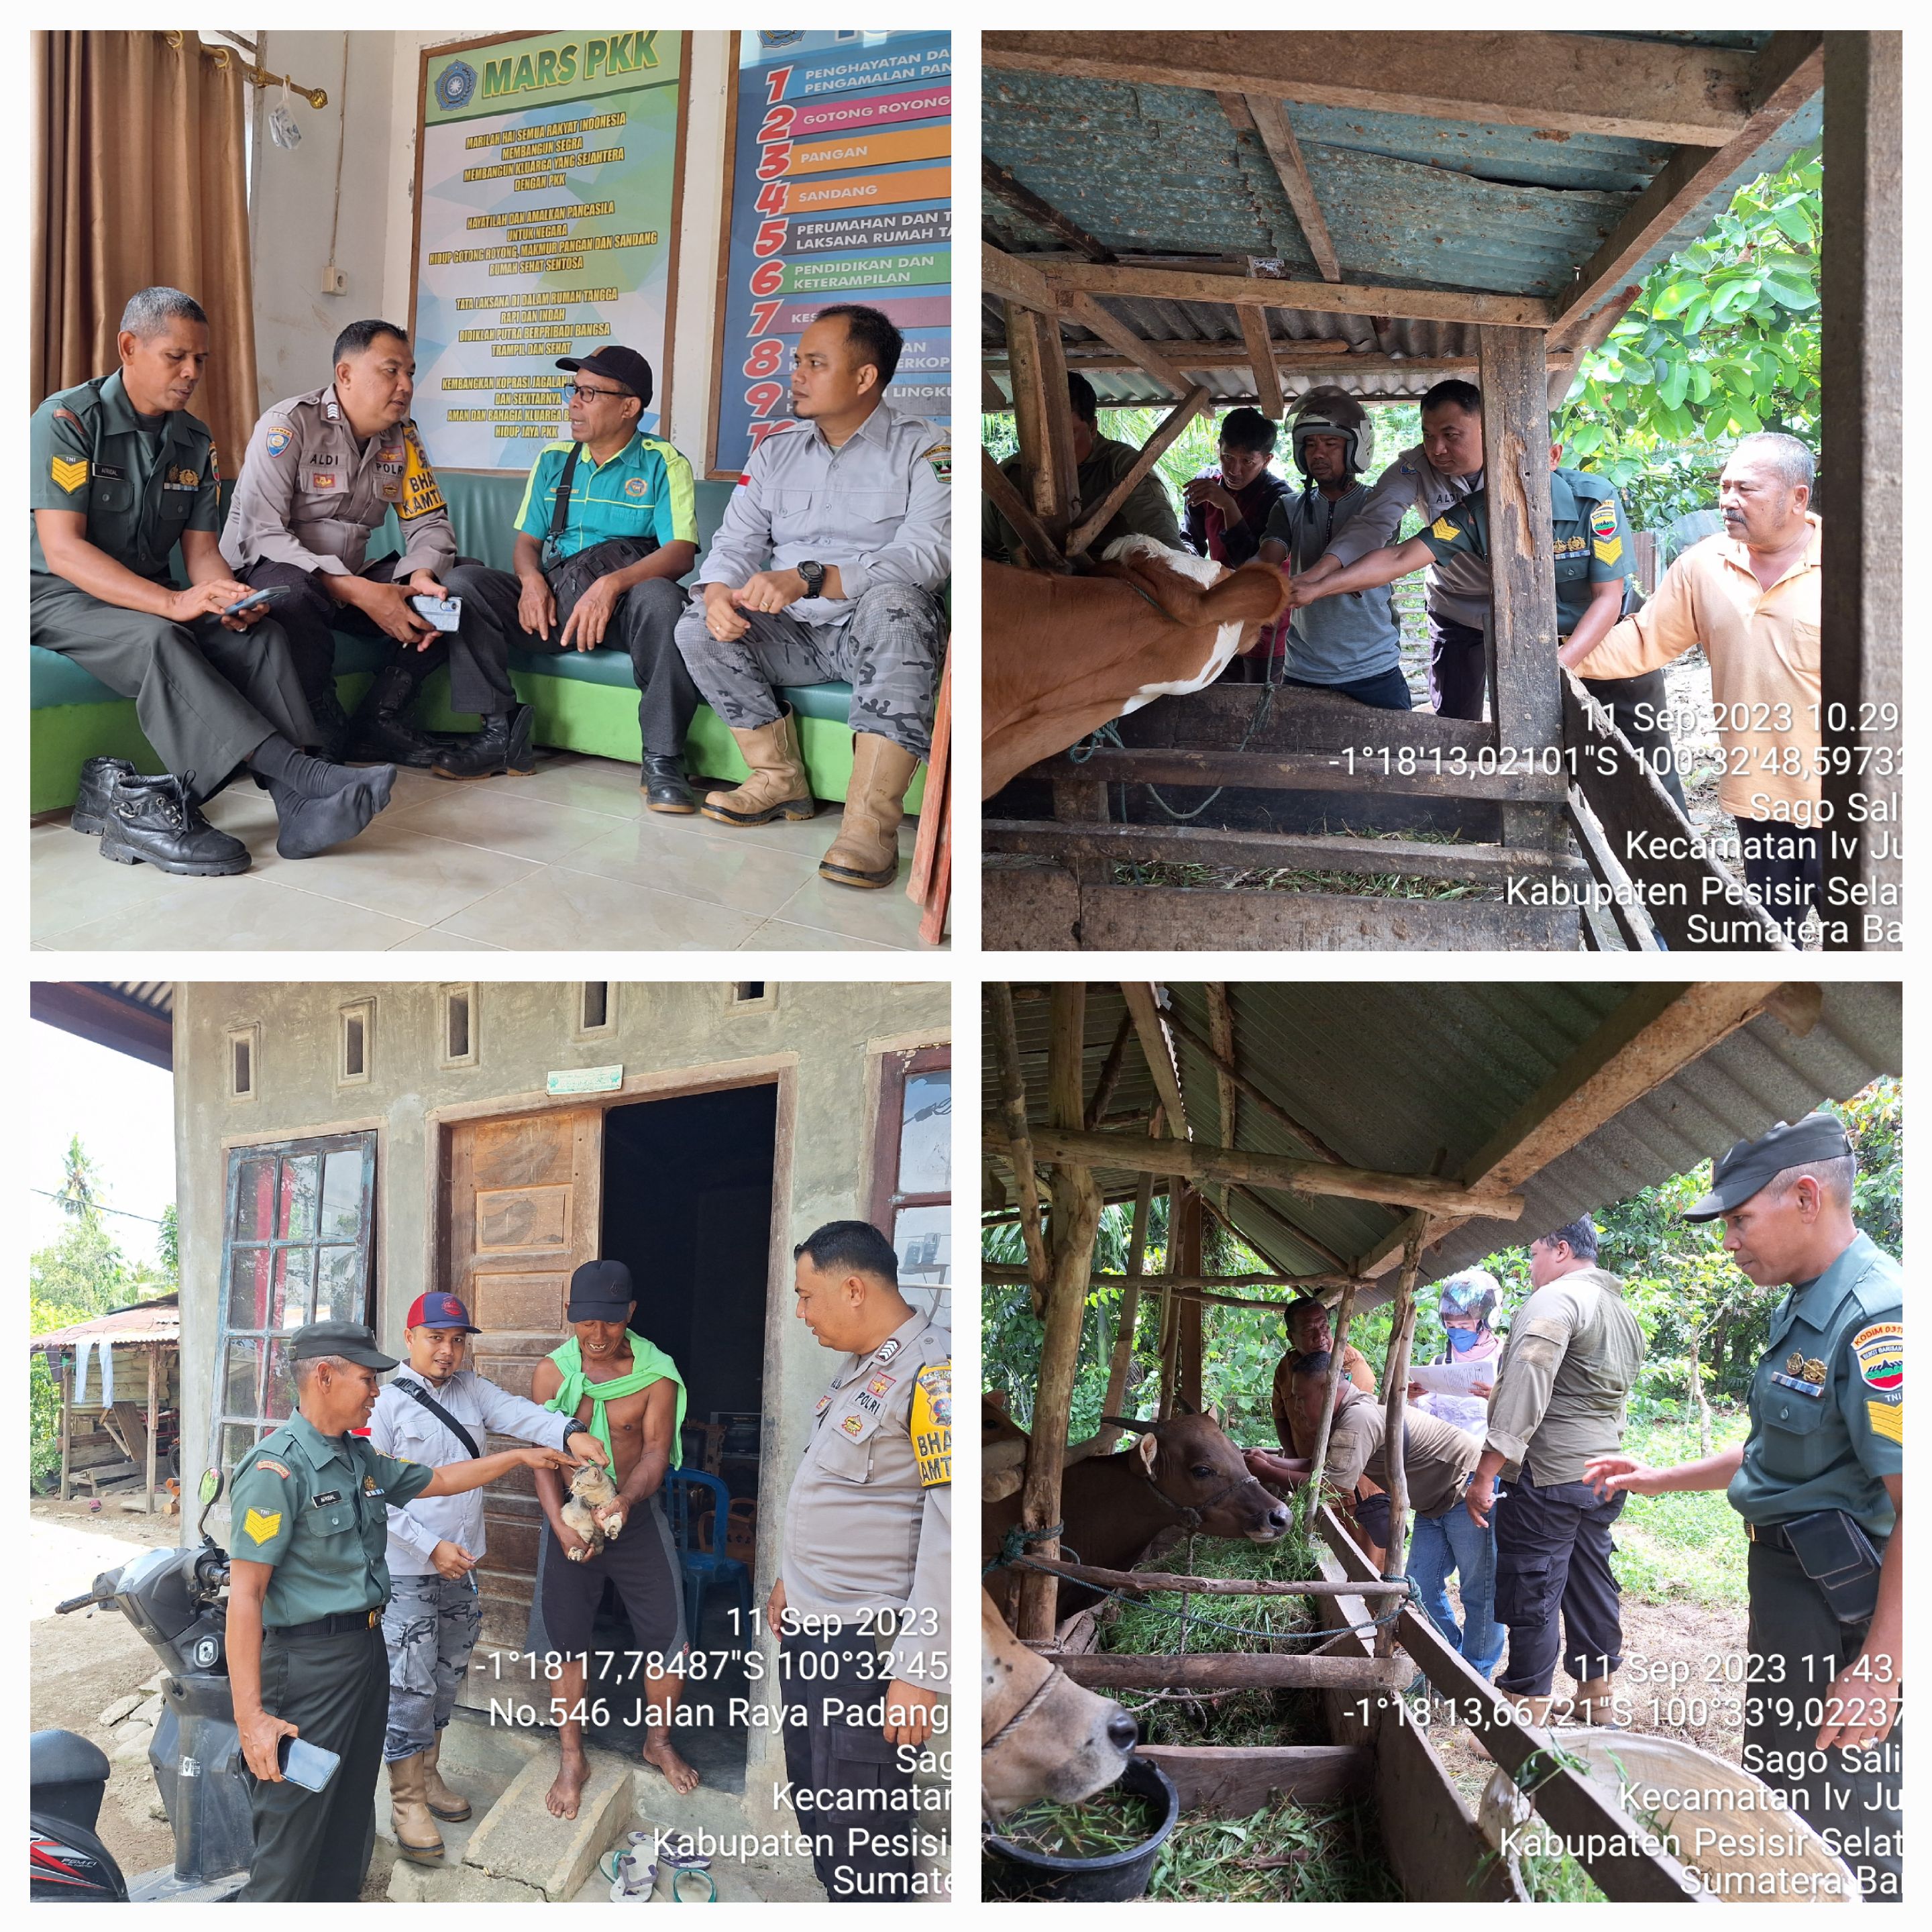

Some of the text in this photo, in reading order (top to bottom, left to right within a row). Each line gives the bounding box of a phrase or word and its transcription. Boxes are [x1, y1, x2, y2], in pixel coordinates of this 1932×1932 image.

[482, 30, 661, 99] MARS PKK
[805, 53, 921, 80] PENGHAYATAN
[765, 65, 794, 105] 1
[805, 68, 915, 93] PENGAMALAN
[803, 96, 951, 125] GOTONG ROYONG
[466, 111, 627, 150] MARILAH HAI SEMUA RAKYAT INDONESIA
[756, 104, 797, 144] 2
[502, 136, 583, 161] MEMBANGUN SEGRA
[800, 146, 867, 164] PANGAN
[464, 147, 625, 182] MEMBANGUN KLUARGA YANG SEJAHTERA
[756, 139, 794, 181] 3
[515, 172, 566, 192] DENGAN PKK
[753, 180, 791, 218] 4
[798, 184, 877, 203] SANDANG
[466, 201, 615, 230] HAYATILAH DAN AMALKAN PANCASILA
[797, 216, 896, 235] PERUMAHAN
[902, 212, 938, 227] DAN
[506, 223, 568, 242] UNTUK NEGARA
[753, 217, 790, 258] 5
[796, 235, 867, 250] LAKSANA
[873, 228, 933, 244] RUMAH
[429, 231, 657, 265] HIDUP GOTONG ROYONG, MAKMUR PANGAN DAN SANDANG
[489, 256, 584, 276] RUMAH SEHAT SENTOSA
[794, 256, 934, 276] PENDIDIKAN DAN
[749, 259, 786, 297] 6
[794, 272, 910, 290] KETERAMPILAN
[456, 287, 618, 310] TATA LAKSANA DI DALAM RUMAH TANGGA
[500, 308, 566, 324] RAPI DAN INDAH
[746, 299, 785, 338] 7
[792, 313, 817, 323] KES
[459, 322, 610, 342] DIDIKLAH PUTRA BERPRIBADI BANGSA
[492, 341, 572, 357] TRAMPIL DAN SEHAT
[743, 338, 784, 380] 8
[896, 357, 951, 369] ERKOP
[441, 377, 494, 390] KEMBANGKAN
[495, 376, 531, 389] KOPRASI
[494, 392, 562, 405] DAN SEKITARNYA
[744, 381, 784, 418] 9
[447, 409, 470, 421] AMAN
[470, 409, 487, 421] DAN
[488, 409, 523, 421] BAHAGIA
[523, 409, 562, 421] KLUARGA
[494, 425, 559, 438] HIDUP JAYA PKK
[310, 454, 339, 465] ALDI
[376, 463, 403, 475] POLR
[1436, 494, 1459, 503] ALDI
[1854, 1327, 1883, 1346] KODIM
[855, 1391, 880, 1415] POLRI
[1884, 1392, 1902, 1402] TNI
